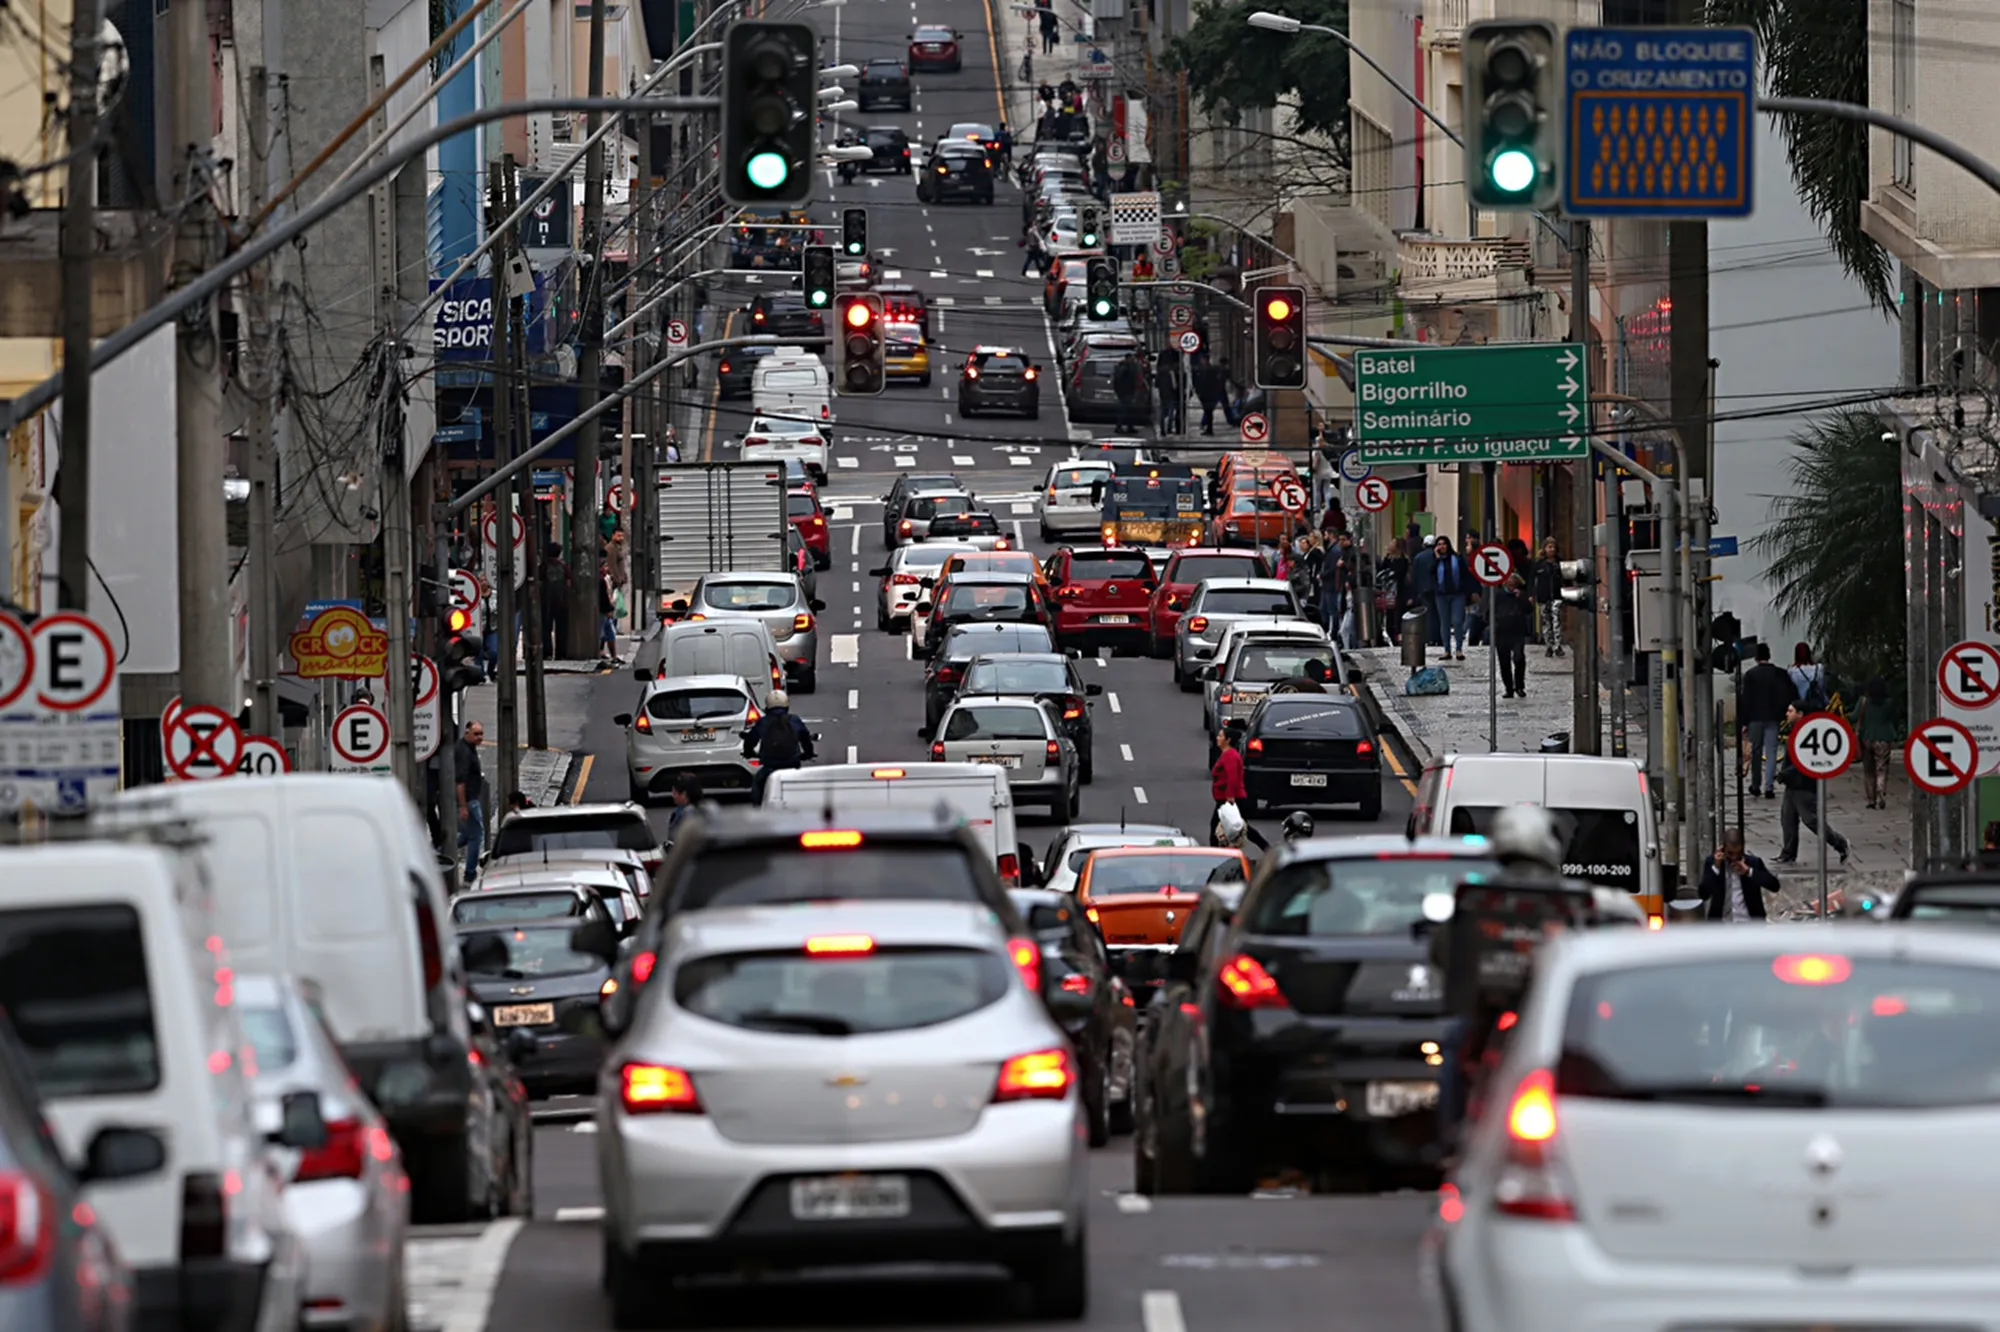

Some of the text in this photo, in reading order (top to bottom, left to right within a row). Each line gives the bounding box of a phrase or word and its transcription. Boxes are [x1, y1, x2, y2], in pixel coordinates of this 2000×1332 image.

[1571, 38, 1745, 61] NÃO BLOQUEIE
[1571, 69, 1747, 87] O CRUZAMENTO
[433, 325, 493, 348] SPOR
[1182, 335, 1197, 348] 40
[1361, 356, 1416, 375] Batel
[1362, 381, 1468, 405] Bigorrilho
[1363, 408, 1472, 430] Seminário
[1364, 439, 1428, 457] BR277
[1454, 438, 1479, 454] do
[1286, 488, 1298, 506] E
[1367, 484, 1380, 504] E
[1484, 552, 1500, 576] E
[49, 634, 83, 690] E
[1960, 656, 1983, 692] E
[350, 718, 372, 751] E
[1800, 728, 1842, 756] 40
[238, 752, 276, 776] 40
[1810, 760, 1833, 768] km/h
[1928, 735, 1954, 777] E
